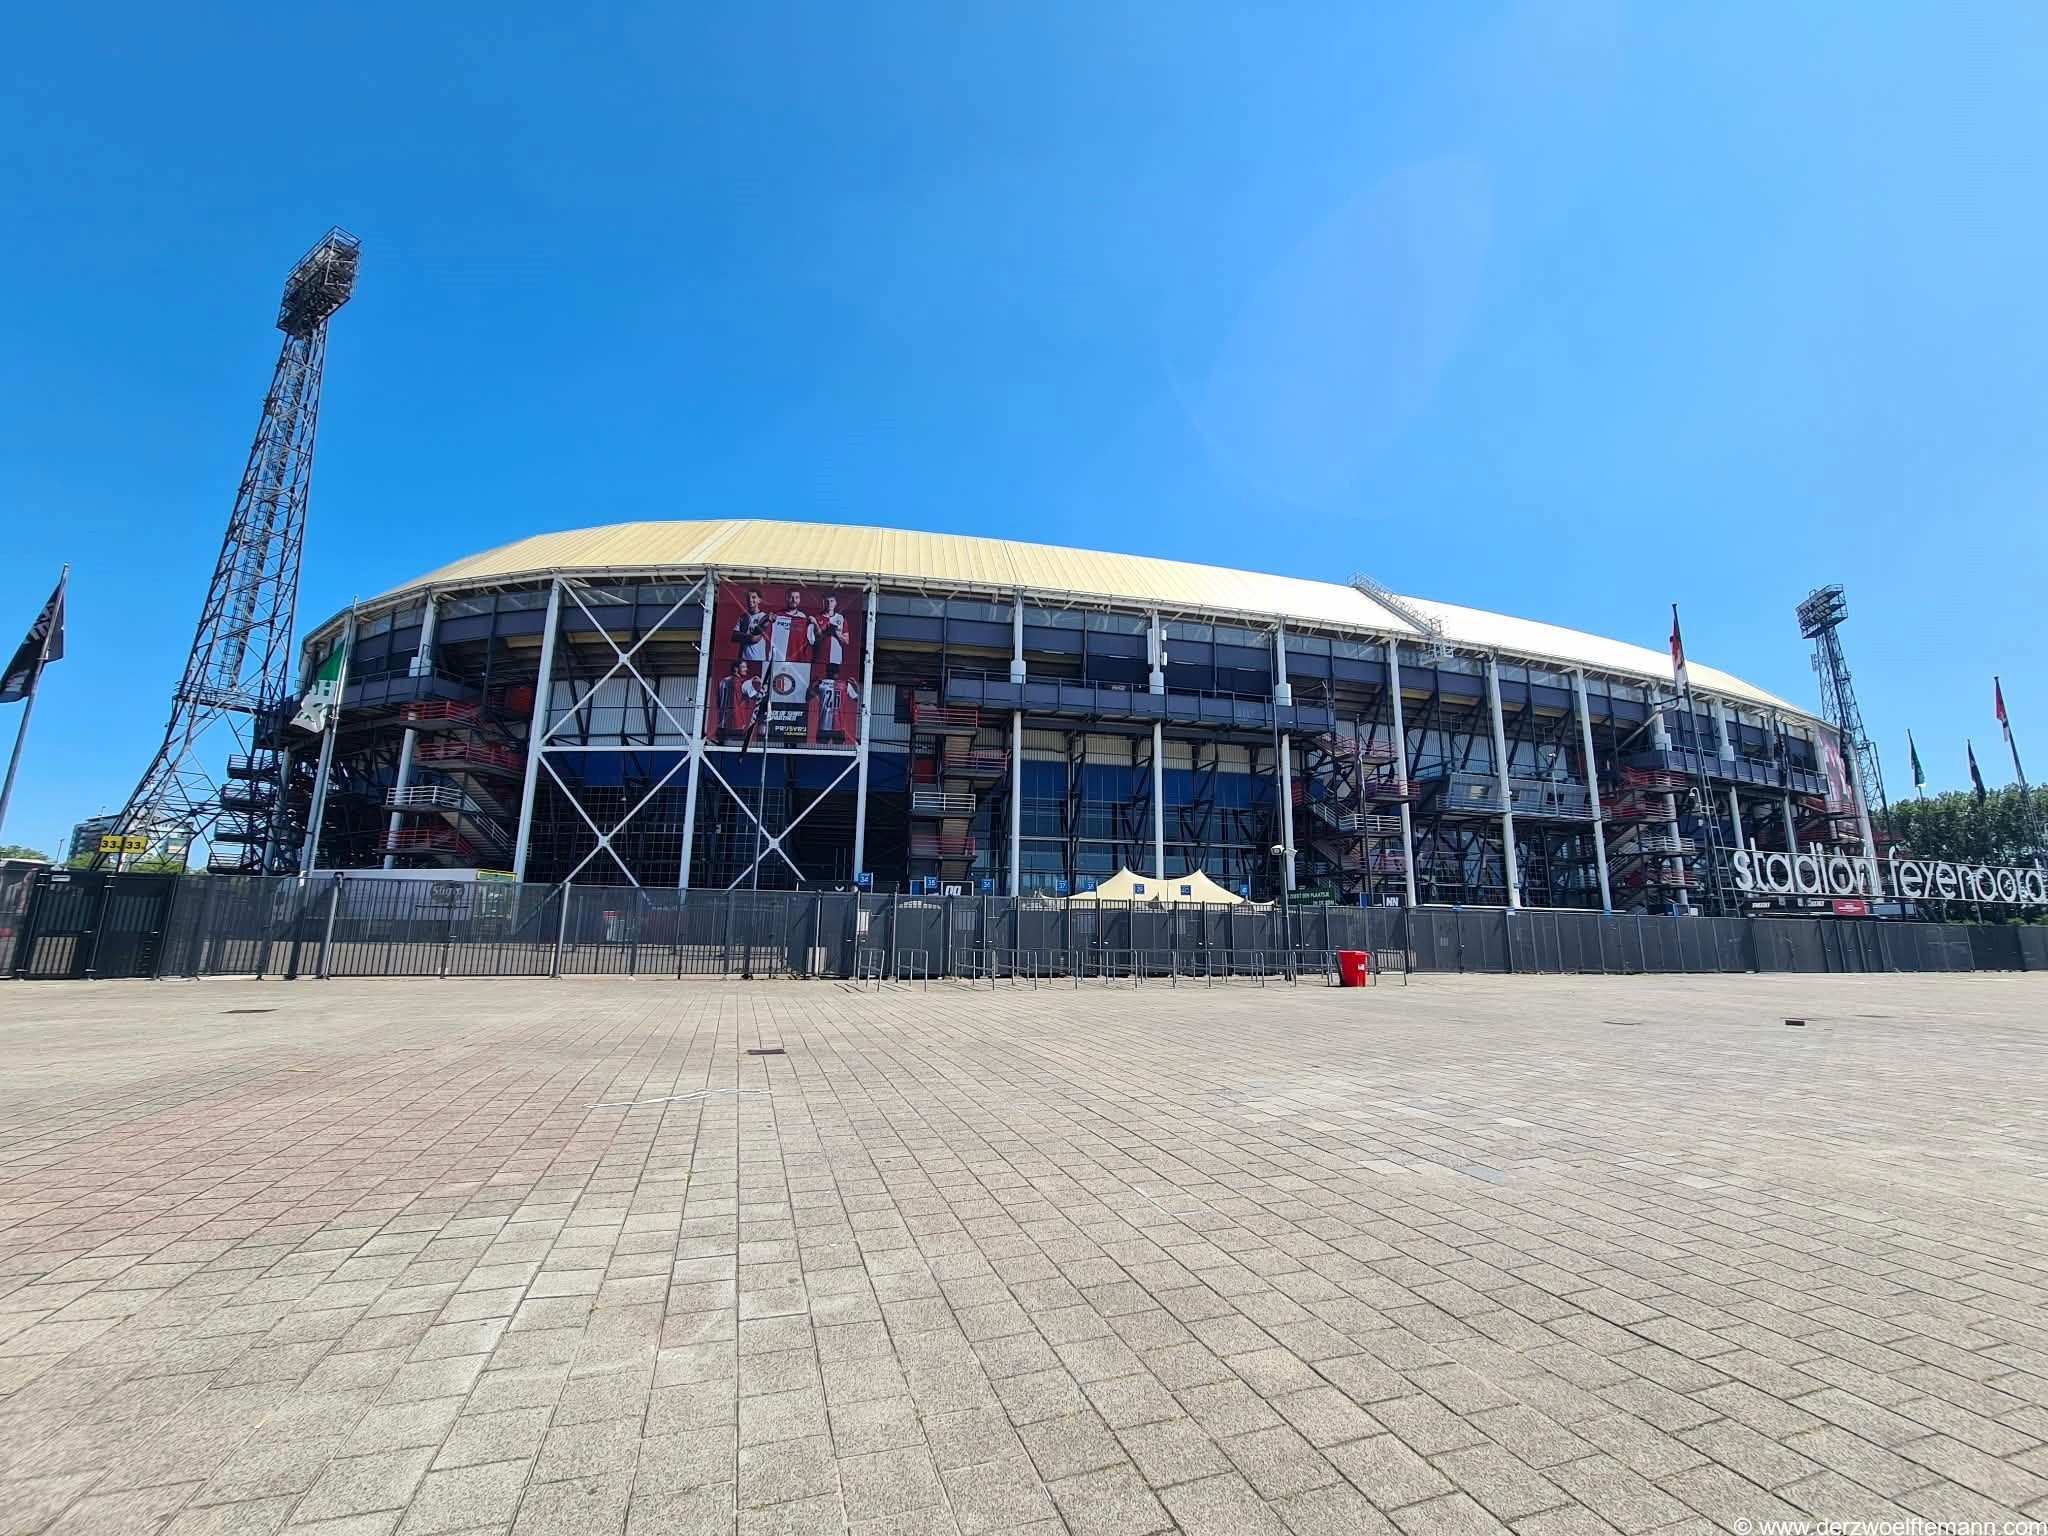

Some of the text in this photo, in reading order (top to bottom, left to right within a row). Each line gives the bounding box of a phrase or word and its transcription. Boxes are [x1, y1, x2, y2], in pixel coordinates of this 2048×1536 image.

[1733, 837, 2048, 903] stadion feyenoord
[1385, 896, 1400, 907] NN
